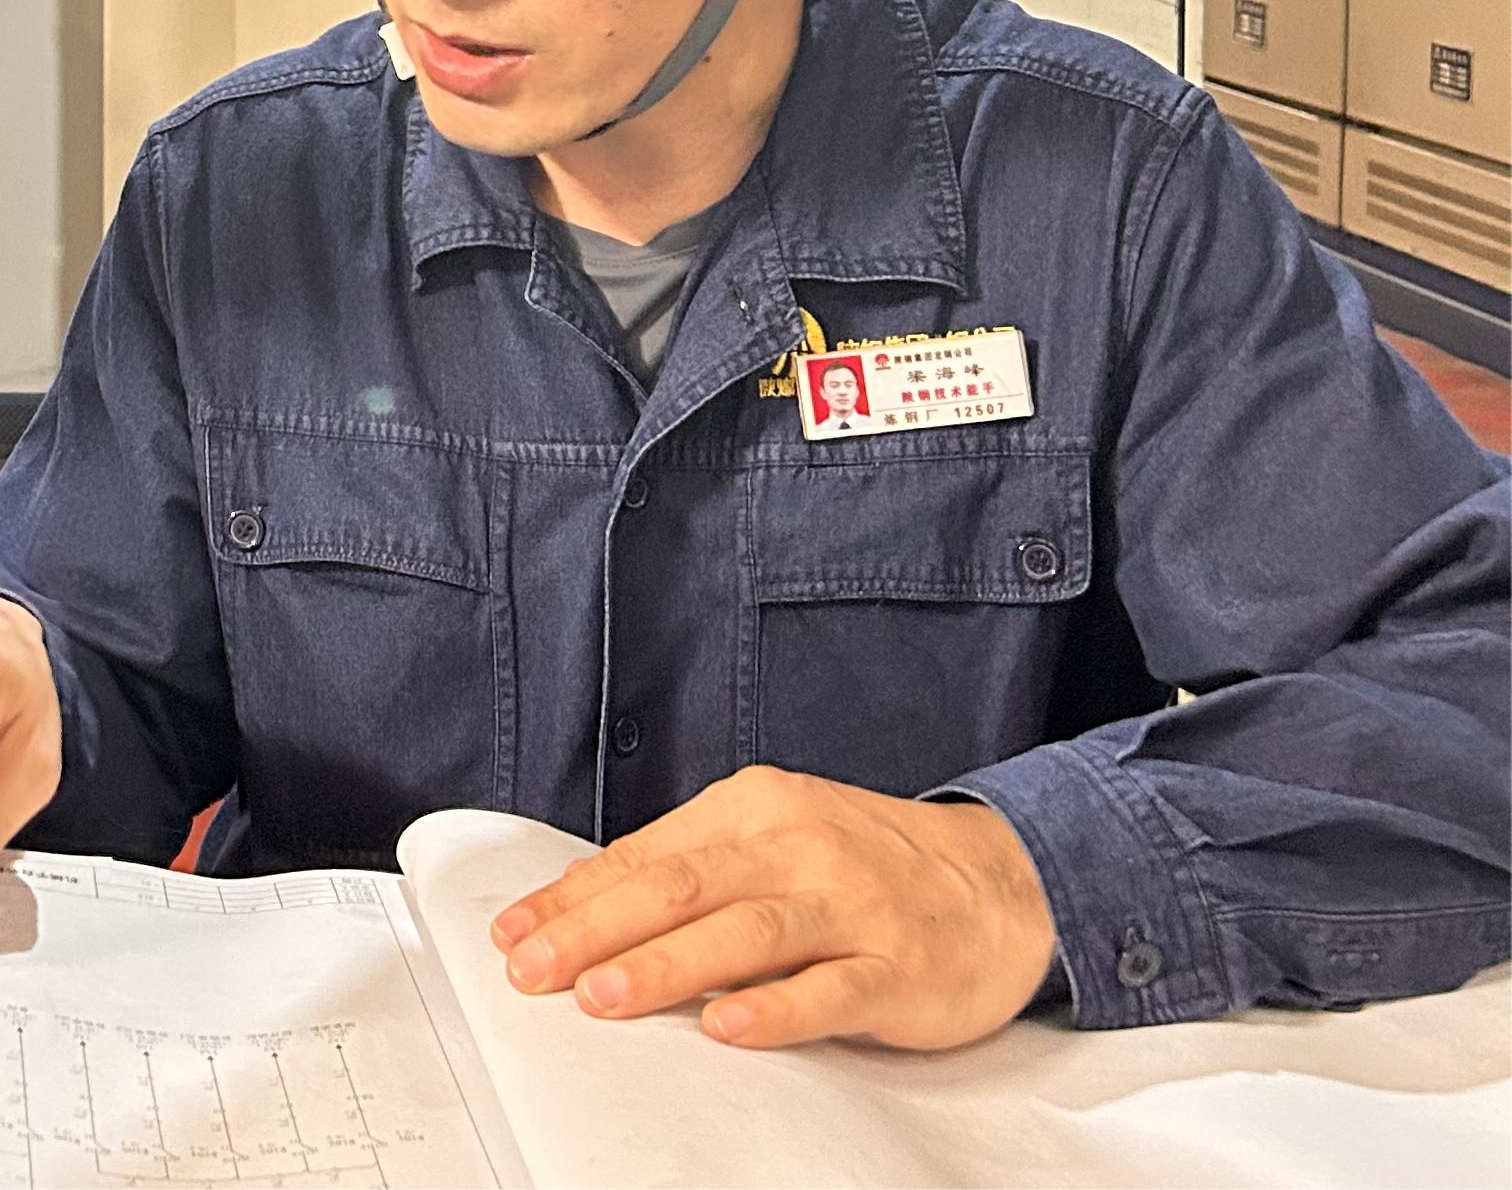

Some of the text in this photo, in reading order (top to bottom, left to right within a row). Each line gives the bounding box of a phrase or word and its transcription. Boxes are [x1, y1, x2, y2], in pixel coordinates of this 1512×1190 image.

[884, 402, 1007, 427] 炼钢厂 12507
